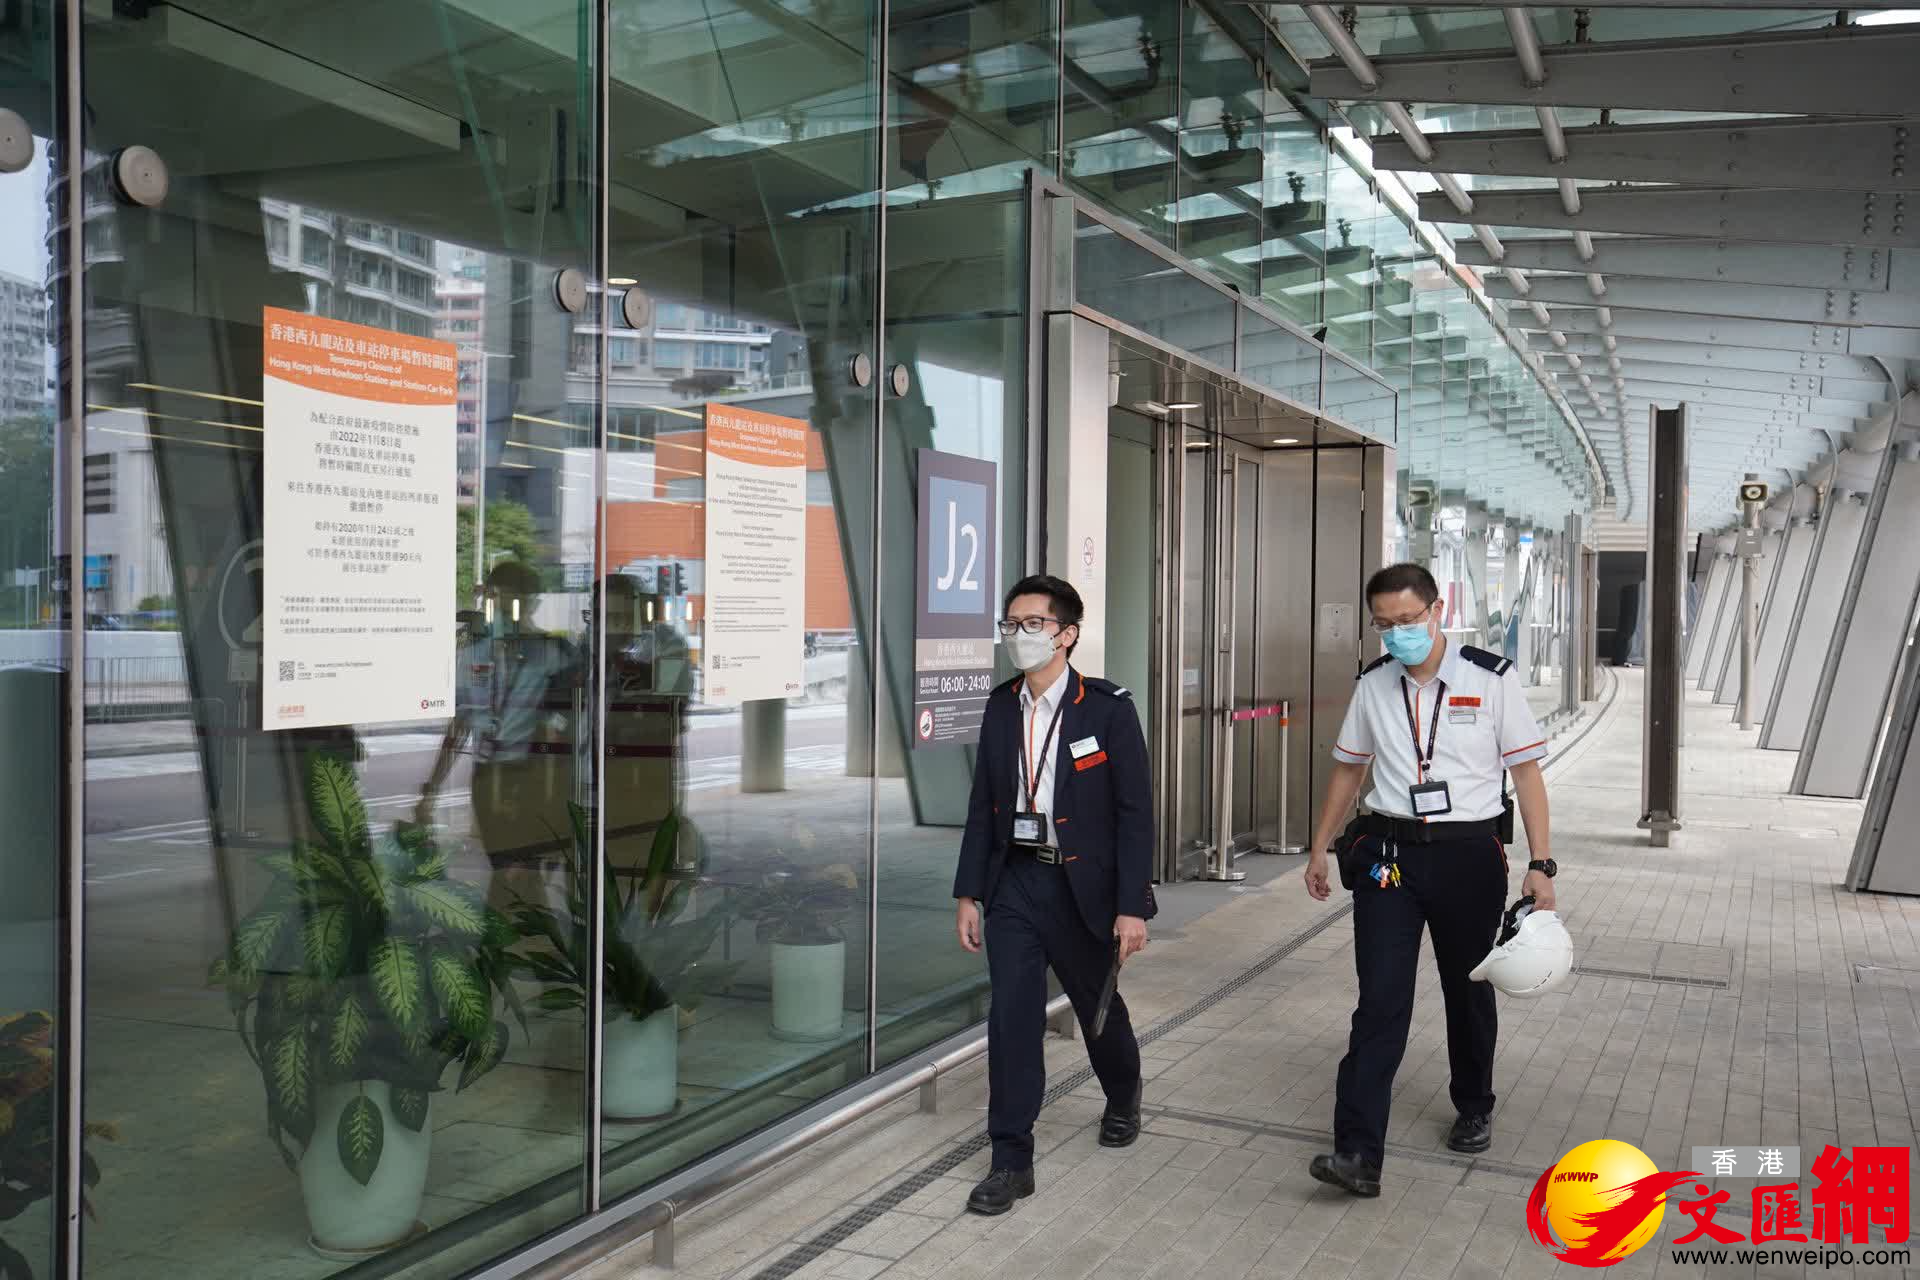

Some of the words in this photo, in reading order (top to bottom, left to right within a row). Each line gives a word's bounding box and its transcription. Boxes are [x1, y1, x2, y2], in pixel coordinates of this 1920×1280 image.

[269, 355, 291, 371] Hong
[292, 360, 313, 375] Kong
[313, 362, 332, 375] West
[364, 372, 389, 385] Station
[389, 376, 402, 387] and
[403, 378, 427, 392] Station
[427, 382, 439, 393] Car
[439, 384, 454, 396] Park
[329, 353, 368, 369] Temporary
[368, 360, 394, 373] Closure
[394, 365, 402, 374] of
[936, 501, 978, 591] J2
[429, 700, 446, 708] MTR
